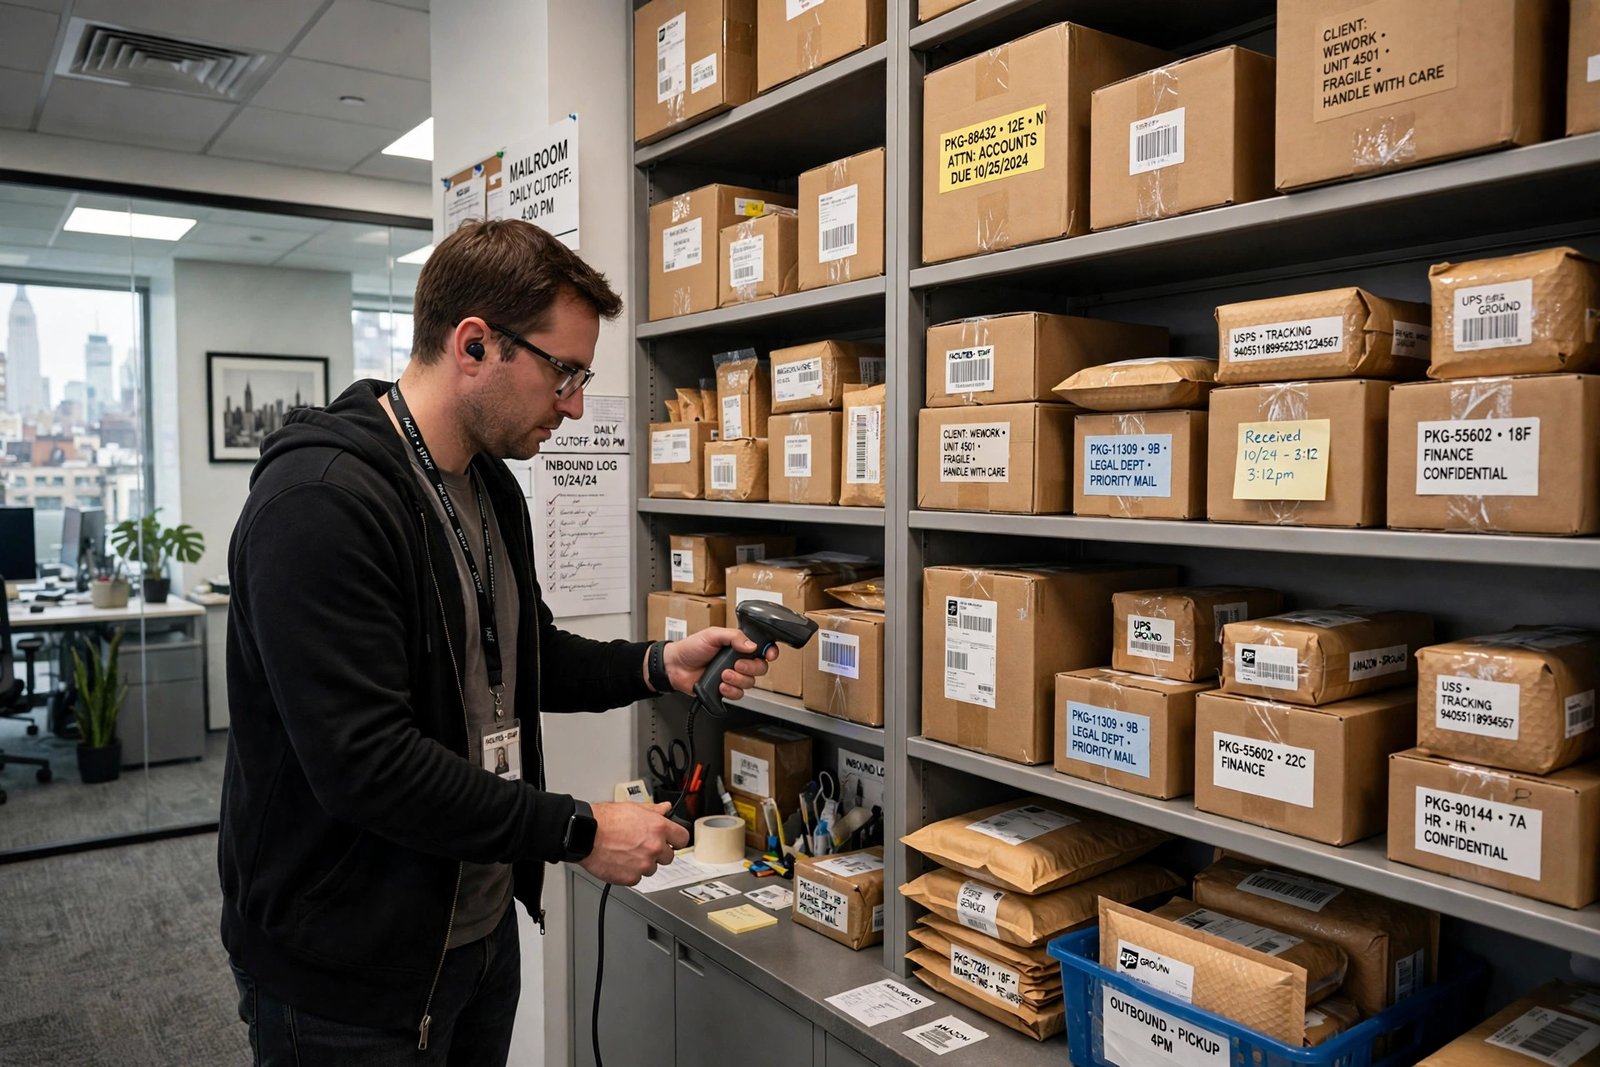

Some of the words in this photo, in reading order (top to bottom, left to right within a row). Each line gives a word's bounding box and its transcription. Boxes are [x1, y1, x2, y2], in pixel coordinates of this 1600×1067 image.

[1323, 18, 1367, 42] CLIENT:
[1323, 31, 1377, 59] WEWORK
[1323, 56, 1350, 75] UNIT
[1353, 48, 1379, 65] 4501
[1323, 67, 1372, 92] FRAGILE
[1323, 85, 1370, 108] HANDLE
[1374, 75, 1405, 94] WITH
[1408, 64, 1444, 86] CARE
[945, 125, 996, 151] PKG-88432
[1007, 117, 1024, 133] 12E
[947, 150, 976, 168] ATTN:
[979, 132, 1037, 160] ACCOUNTS
[510, 139, 567, 183] MAILROOM
[951, 168, 972, 185] DUE
[974, 153, 1028, 179] 10/25/2024
[510, 183, 532, 206] DAILY
[534, 168, 571, 195] CUTOFF:
[541, 197, 554, 216] PM
[1462, 295, 1482, 306] UPS
[1478, 301, 1521, 315] GROUND
[1234, 332, 1256, 344] USPS
[1266, 325, 1312, 341] TRACKING
[594, 425, 618, 434] DAILY
[943, 429, 968, 439] CLIENT:
[970, 428, 1000, 438] WEWORK
[1245, 428, 1301, 443] Received
[1424, 428, 1492, 443] PKG-55602
[1508, 427, 1532, 441] 18F
[613, 438, 625, 447] PM
[944, 442, 958, 451] UNIT
[961, 442, 975, 451] 4501
[1091, 443, 1138, 455] PKG-11309
[1148, 443, 1160, 454] 9B
[944, 454, 970, 464] FRAGILE
[1244, 447, 1277, 463] 10/24
[1294, 448, 1318, 461] 3:12
[1424, 448, 1474, 461] FINANCE
[545, 460, 593, 471] INBOUND
[597, 461, 617, 471] LOG
[943, 467, 968, 476] HANDLE
[970, 467, 986, 476] WITH
[988, 467, 1006, 476] CARE
[1091, 460, 1118, 470] LEGAL
[1121, 460, 1144, 470] DEPT
[553, 474, 597, 487] 10/24/24
[1090, 475, 1132, 486] PRIORITY
[1134, 476, 1157, 486] MAIL
[1247, 468, 1294, 486] 3:12pm
[1423, 467, 1508, 480] CONFIDENTIAL
[1134, 620, 1151, 631] UPS
[1442, 681, 1462, 693] USS
[1441, 695, 1492, 711] TRACKING
[1072, 709, 1117, 729] PKG-11309
[1126, 721, 1138, 734] 9B
[1072, 725, 1099, 741] LEGAL
[1102, 732, 1124, 746] DEPT
[1072, 740, 1112, 759] PRIORITY
[1114, 750, 1137, 765] MAIL
[1219, 740, 1273, 762] PKG-55602
[1285, 753, 1306, 768] 22C
[1222, 756, 1265, 777] FINANCE
[1425, 795, 1493, 822] PKG-90144
[1509, 813, 1526, 829] 7A
[1425, 813, 1441, 828] HR
[1424, 830, 1508, 861] CONFIDENTIAL
[998, 971, 1011, 984] 18F
[1110, 996, 1167, 1032] OUTBOUND
[1178, 1027, 1220, 1055] PICKUP
[1151, 1033, 1173, 1053] 4PM
